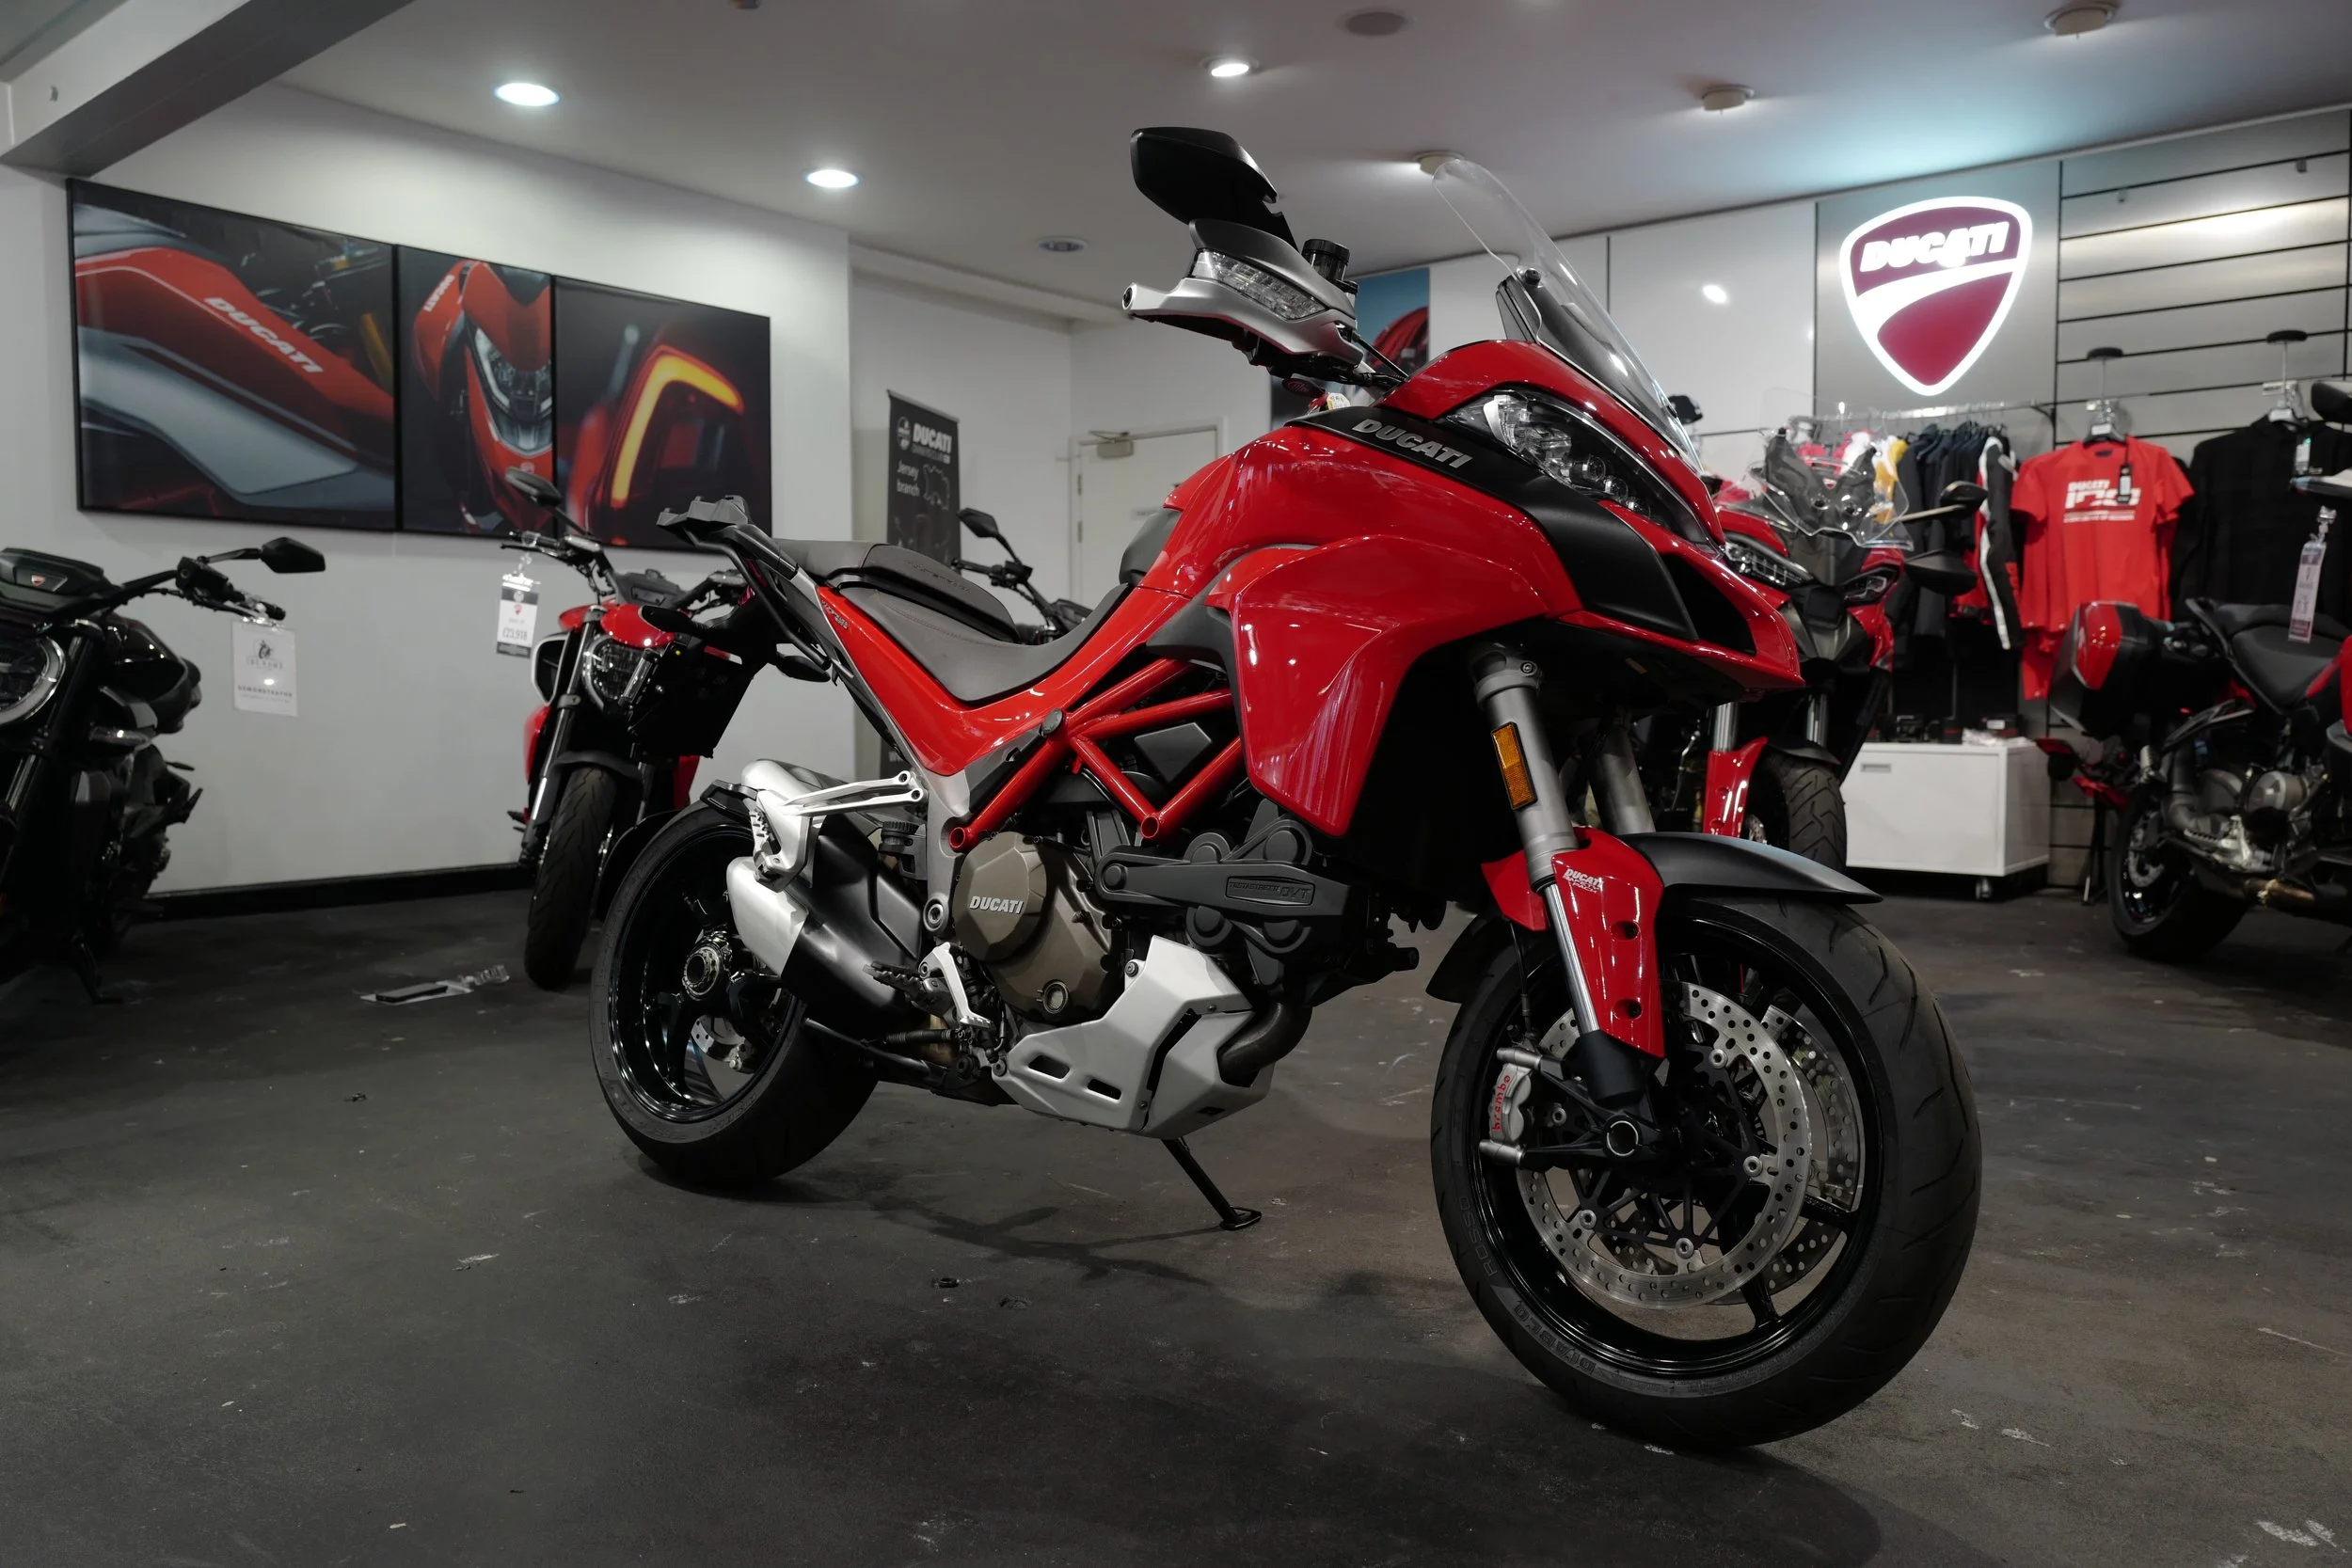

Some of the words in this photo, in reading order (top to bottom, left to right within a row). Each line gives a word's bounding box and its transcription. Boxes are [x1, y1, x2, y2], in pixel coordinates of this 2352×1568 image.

[1859, 221, 2010, 272] DUCATI
[203, 297, 324, 372] DUCATI
[913, 422, 952, 454] DUCATI
[1352, 419, 1473, 468] DUCATI
[1564, 868, 1603, 888] DUCATI
[969, 895, 1024, 914] DUCATI
[1491, 1075, 1511, 1132] brembo
[1459, 1196, 1498, 1277] ROSSO
[1513, 1300, 1597, 1374] DIABLO
